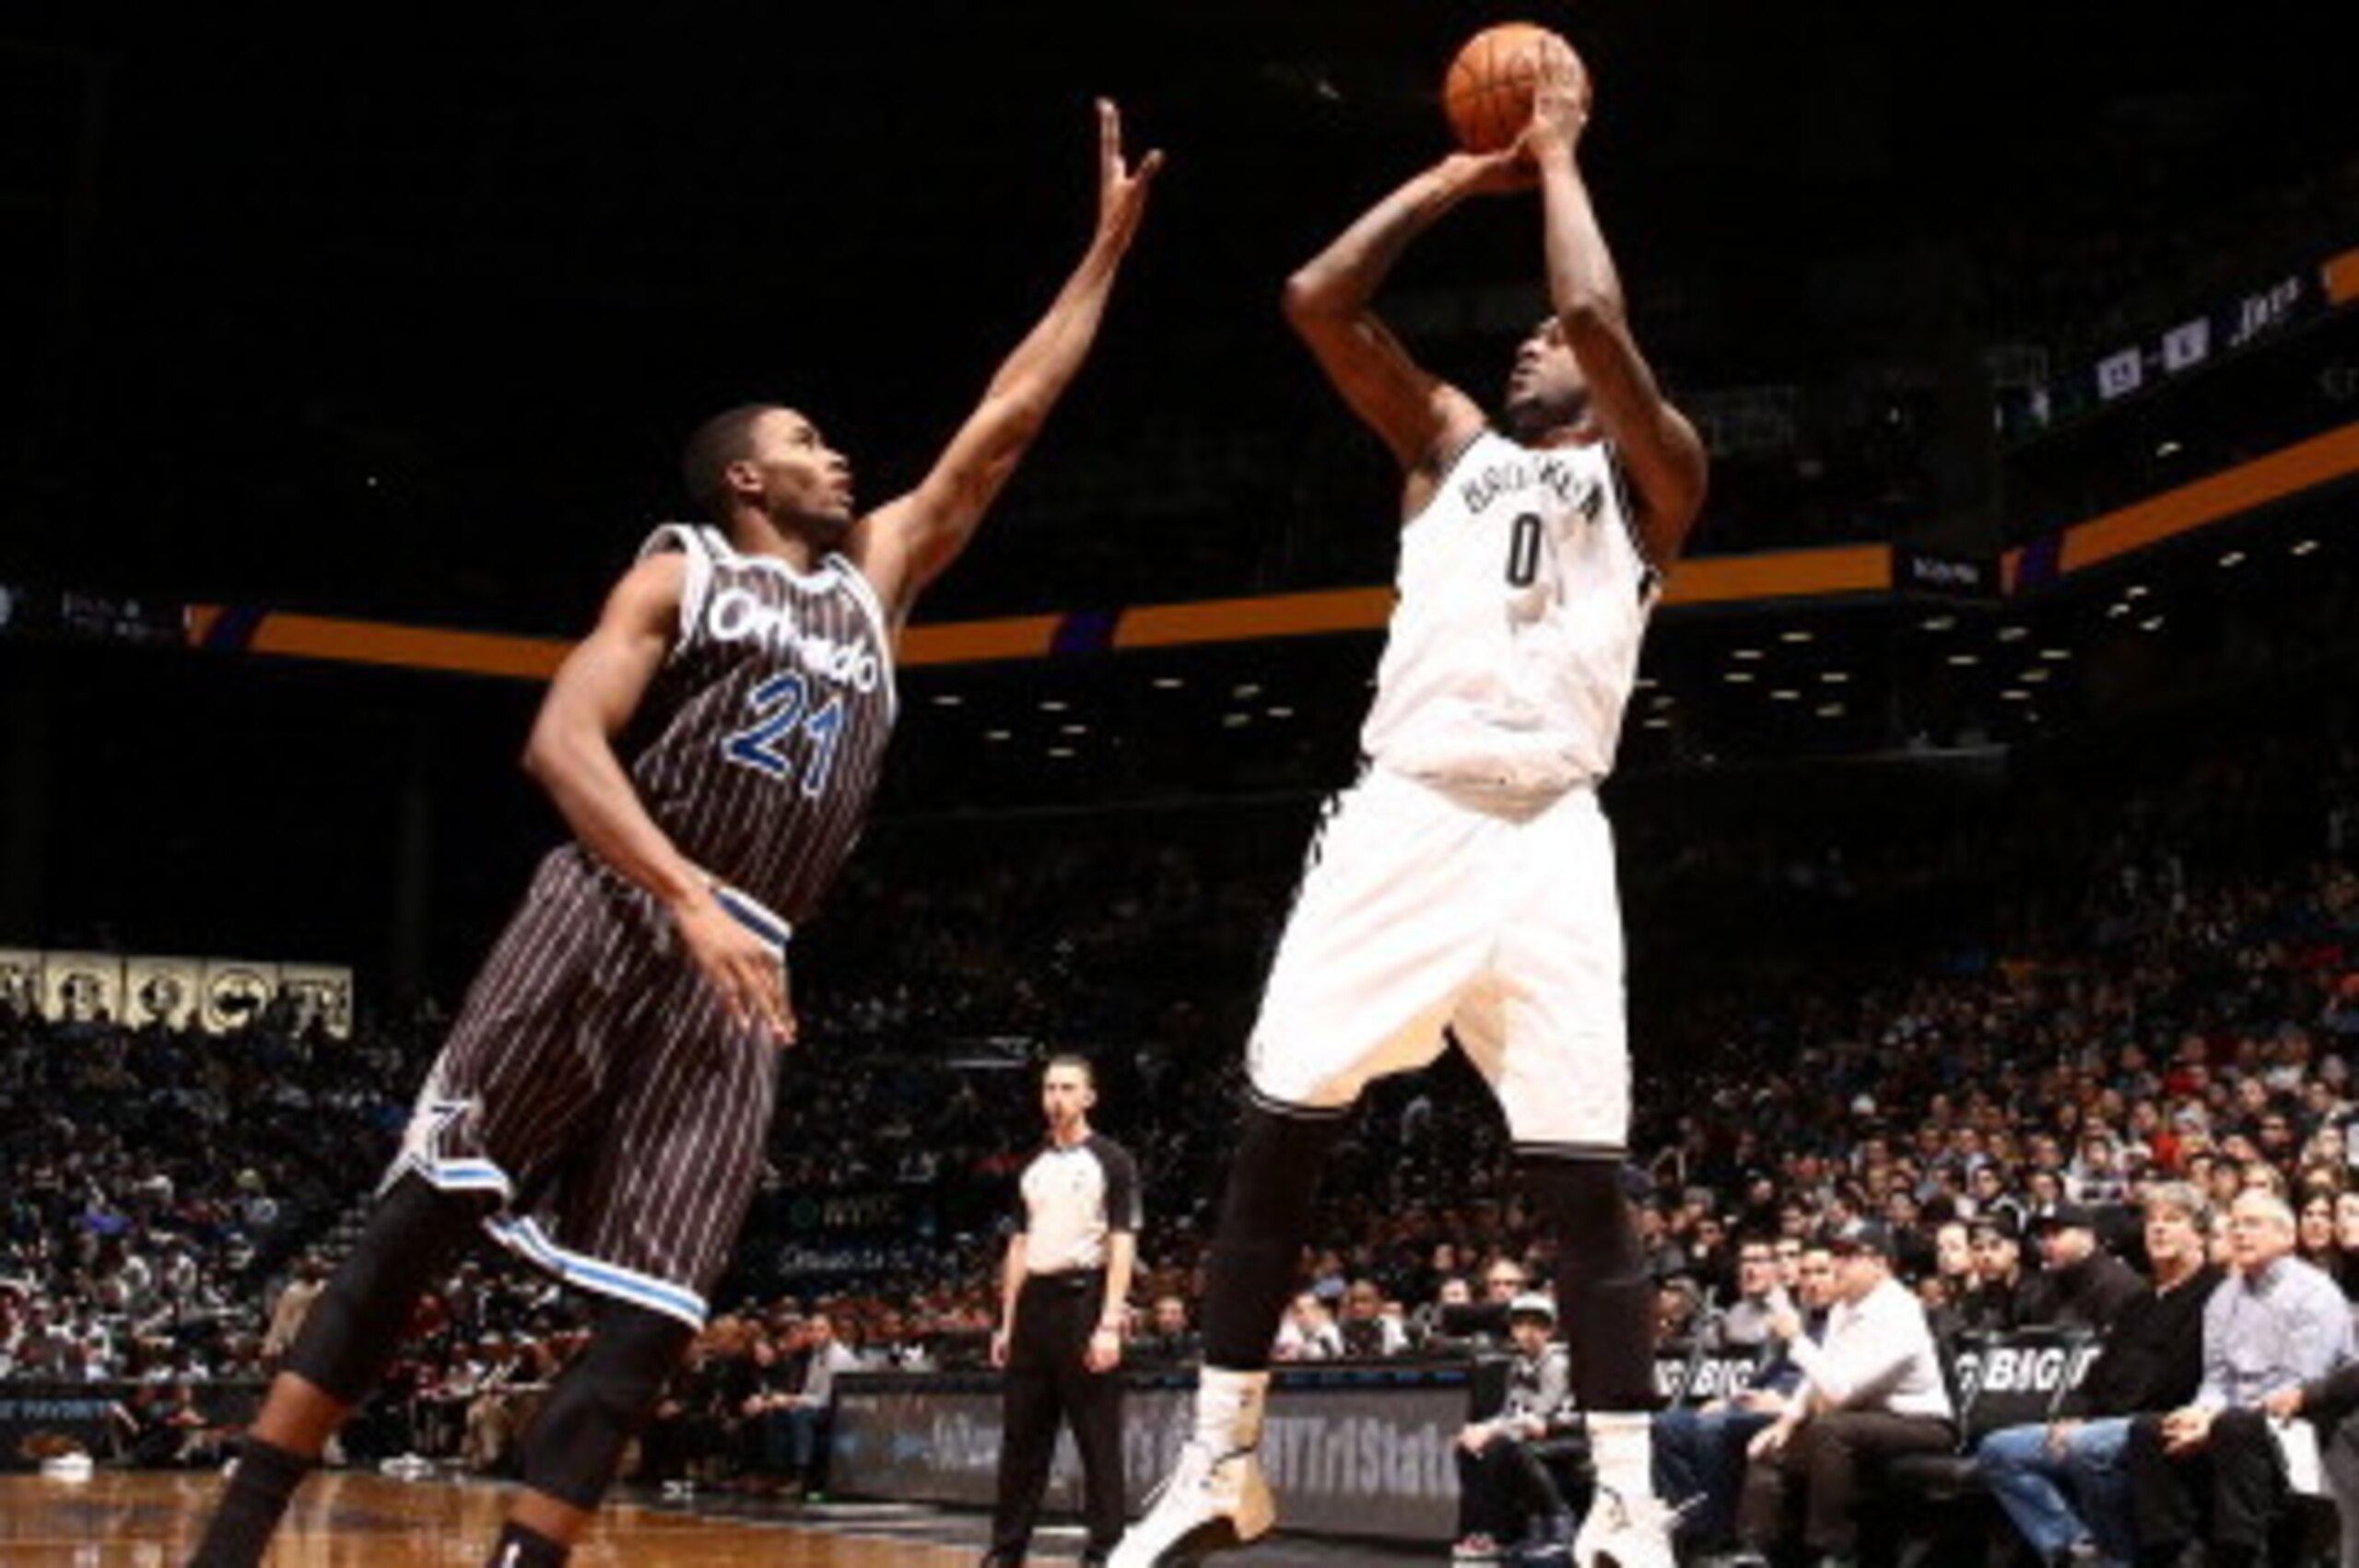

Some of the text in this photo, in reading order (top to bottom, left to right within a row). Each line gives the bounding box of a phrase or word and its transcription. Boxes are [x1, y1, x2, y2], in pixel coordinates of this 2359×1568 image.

[1505, 509, 1543, 588] 0
[709, 590, 877, 692] Orlando
[721, 671, 845, 797] 21
[1983, 1346, 2065, 1392] BIG
